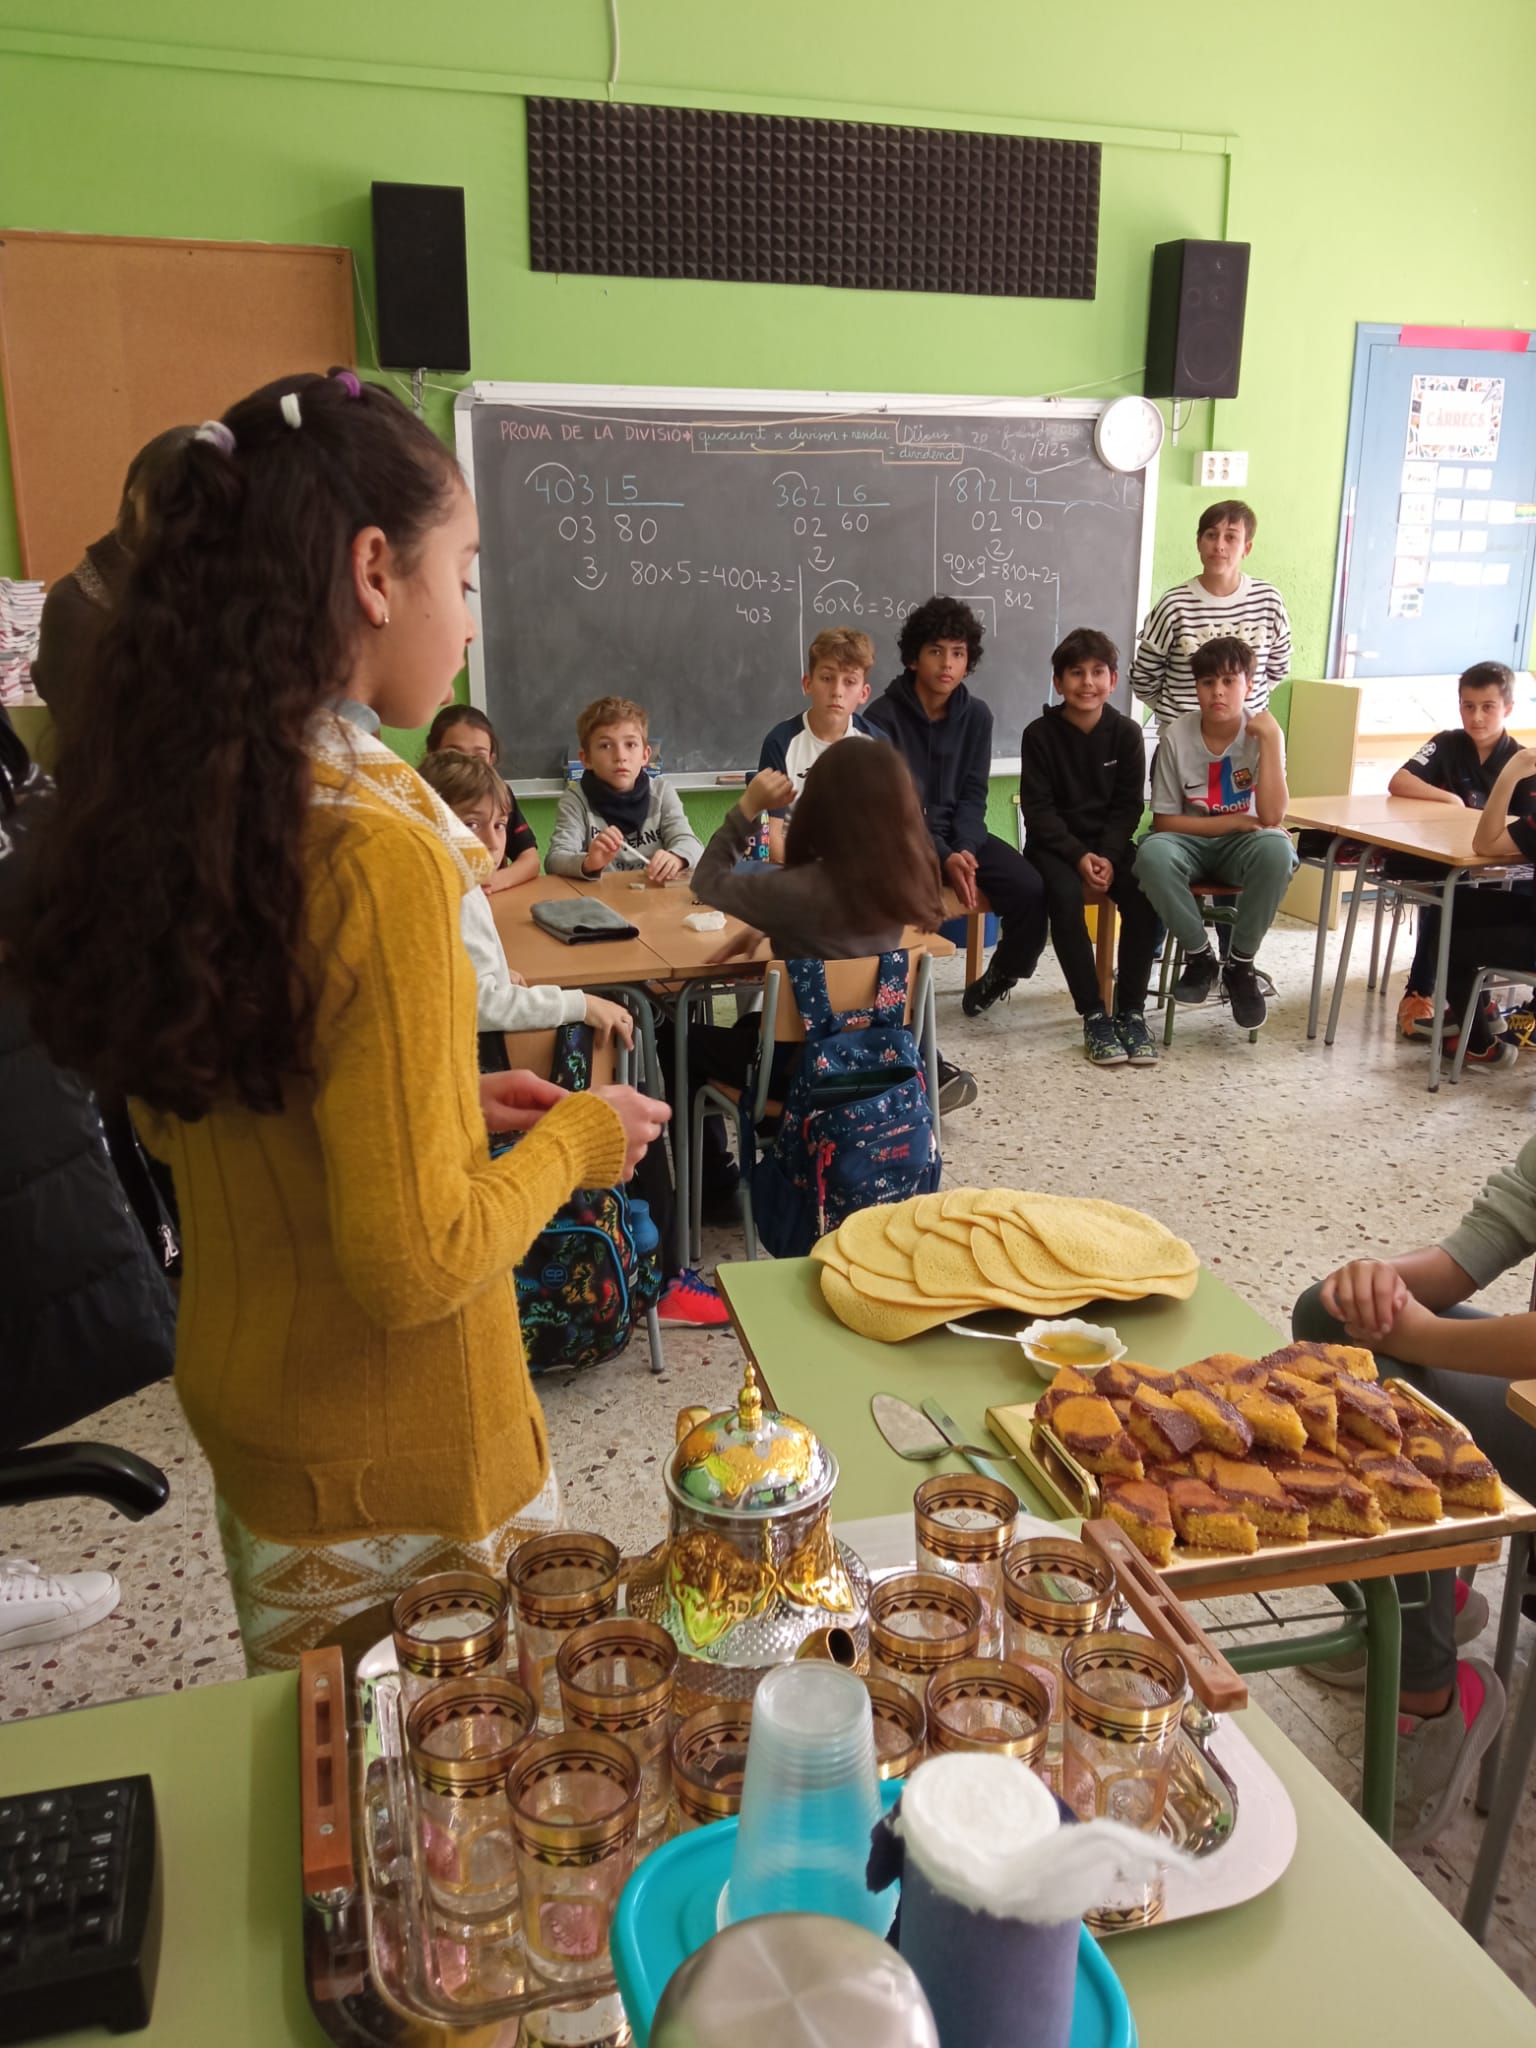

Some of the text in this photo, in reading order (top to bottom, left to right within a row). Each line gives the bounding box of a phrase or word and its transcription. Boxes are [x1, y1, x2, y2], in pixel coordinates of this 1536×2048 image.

[500, 420, 552, 441] PROVA
[561, 424, 584, 441] DE
[594, 424, 614, 440] LA
[900, 446, 959, 461] dividend
[535, 474, 594, 505] 403
[623, 475, 638, 500] 5
[777, 485, 826, 507] 362
[854, 484, 867, 502] 6
[956, 477, 1000, 503] 812
[1026, 477, 1037, 499] 9
[794, 517, 827, 537] 02
[842, 512, 869, 532] 60
[972, 511, 1002, 531] 02
[1011, 506, 1042, 530] 90
[559, 516, 596, 544] 03
[614, 514, 657, 544] 80
[813, 546, 826, 563] 2
[990, 539, 1005, 555] 2
[583, 556, 598, 579] 3
[1004, 589, 1034, 610] 812
[736, 604, 771, 624] 403
[1212, 797, 1251, 813] Spoti
[622, 828, 662, 852] EANS
